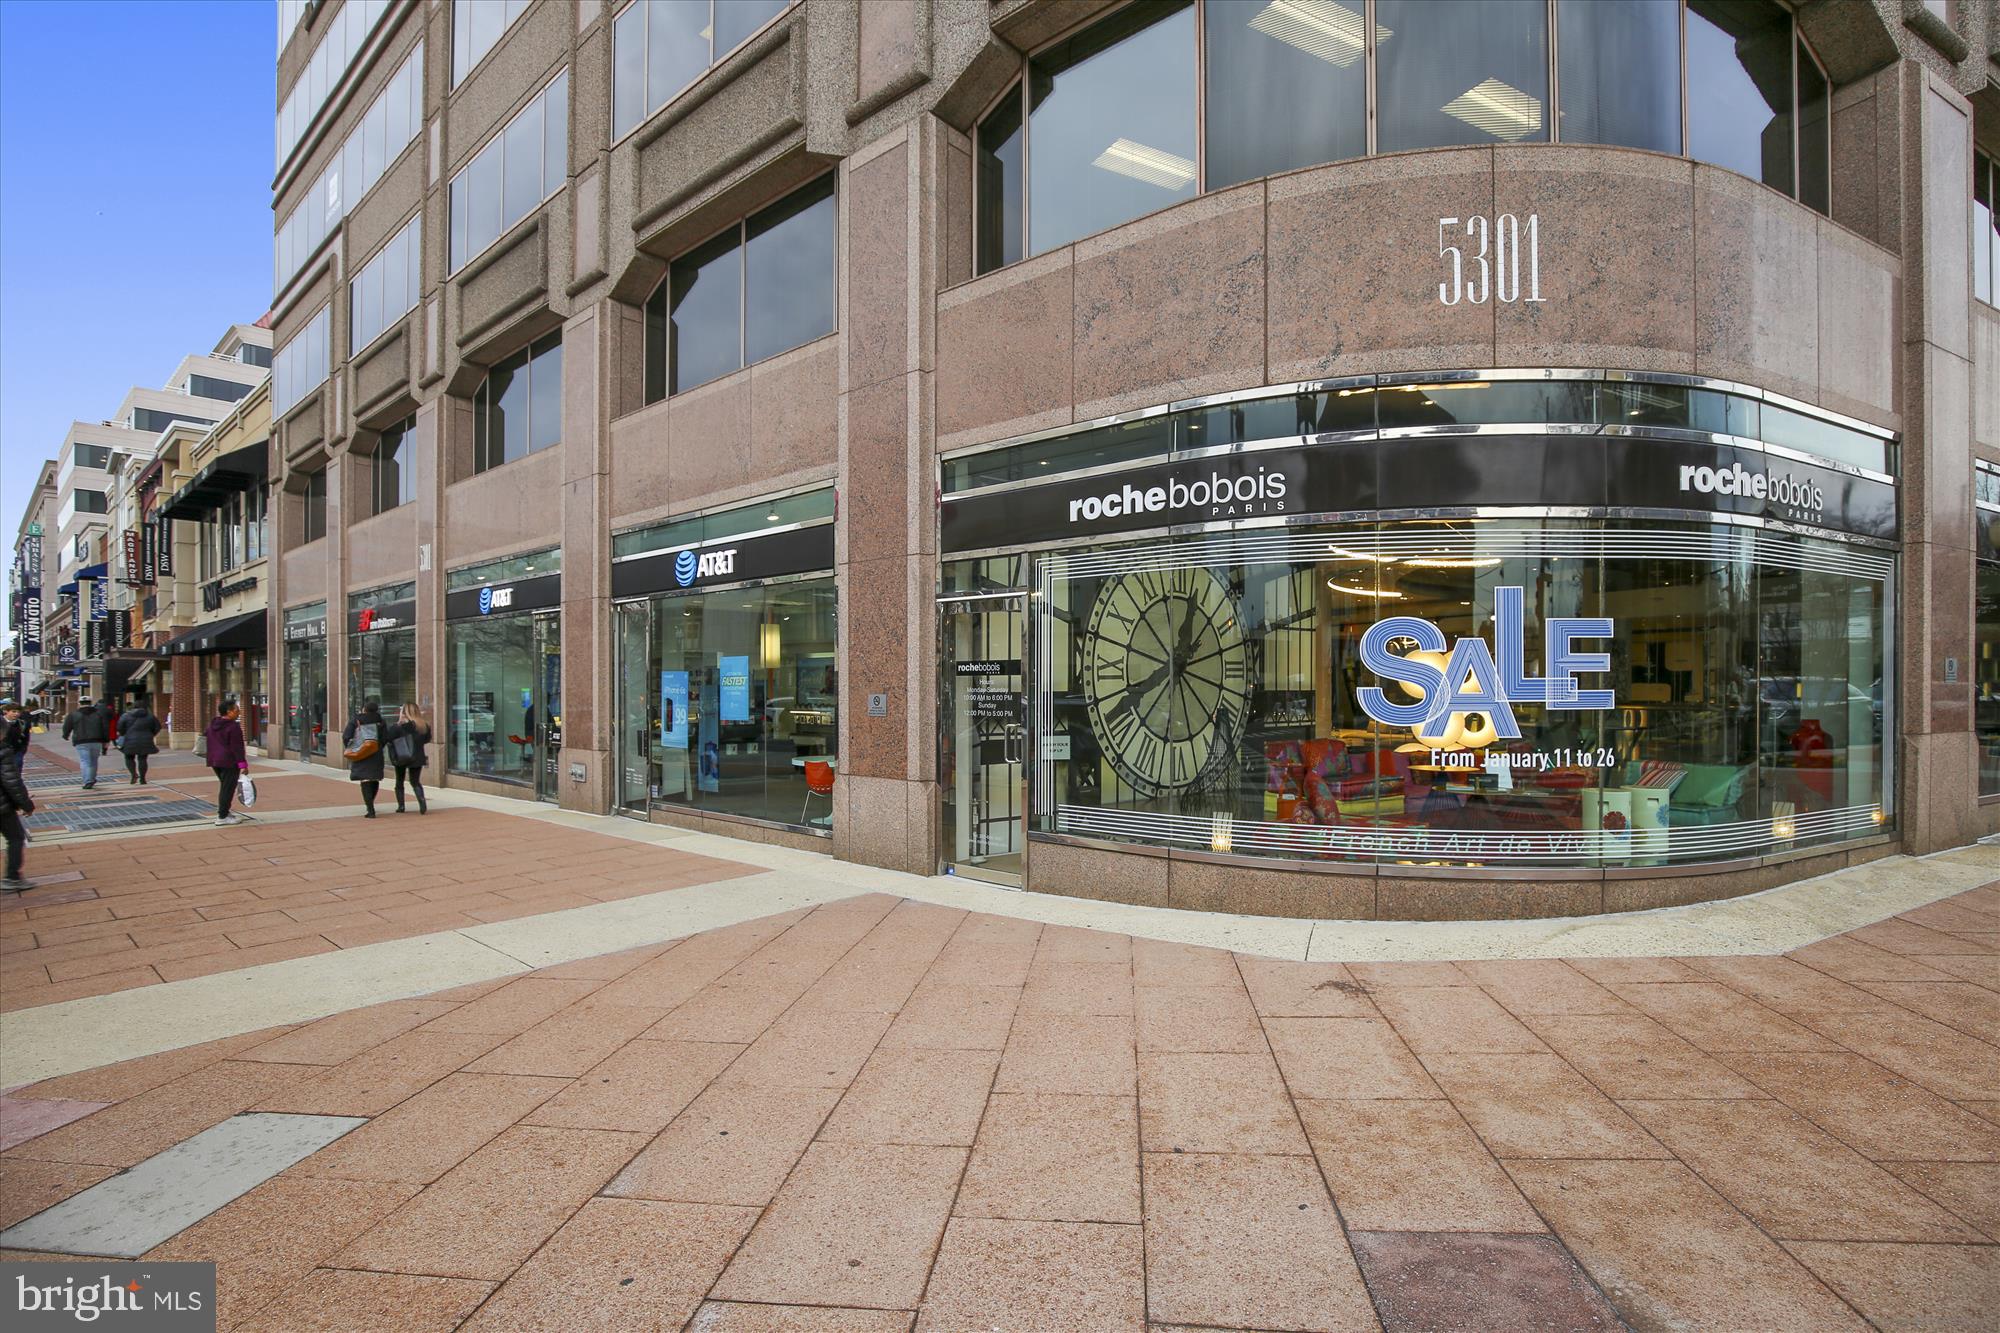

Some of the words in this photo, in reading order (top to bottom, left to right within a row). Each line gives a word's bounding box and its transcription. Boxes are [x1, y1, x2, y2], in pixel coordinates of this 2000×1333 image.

[1439, 214, 1547, 305] 5301
[1069, 467, 1286, 522] rochebobois
[1680, 462, 1823, 511] rochebobois
[1213, 501, 1285, 515] PARIS
[1788, 509, 1822, 523] PARIS
[160, 553, 169, 571] DSW
[697, 549, 737, 578] AT&T
[145, 564, 153, 581] DSW
[28, 597, 40, 616] OLD
[490, 588, 513, 608] AT&T
[28, 617, 40, 643] NAVY
[958, 662, 1000, 671] rochebobois
[1356, 586, 1616, 738] SALE
[721, 676, 748, 686] FASTEST
[1431, 748, 1475, 767] From
[1480, 748, 1549, 772] January
[1554, 749, 1571, 768] 11
[1577, 750, 1592, 767] to
[1596, 748, 1615, 767] 26
[1443, 833, 1486, 853] Art
[1499, 835, 1531, 853] de
